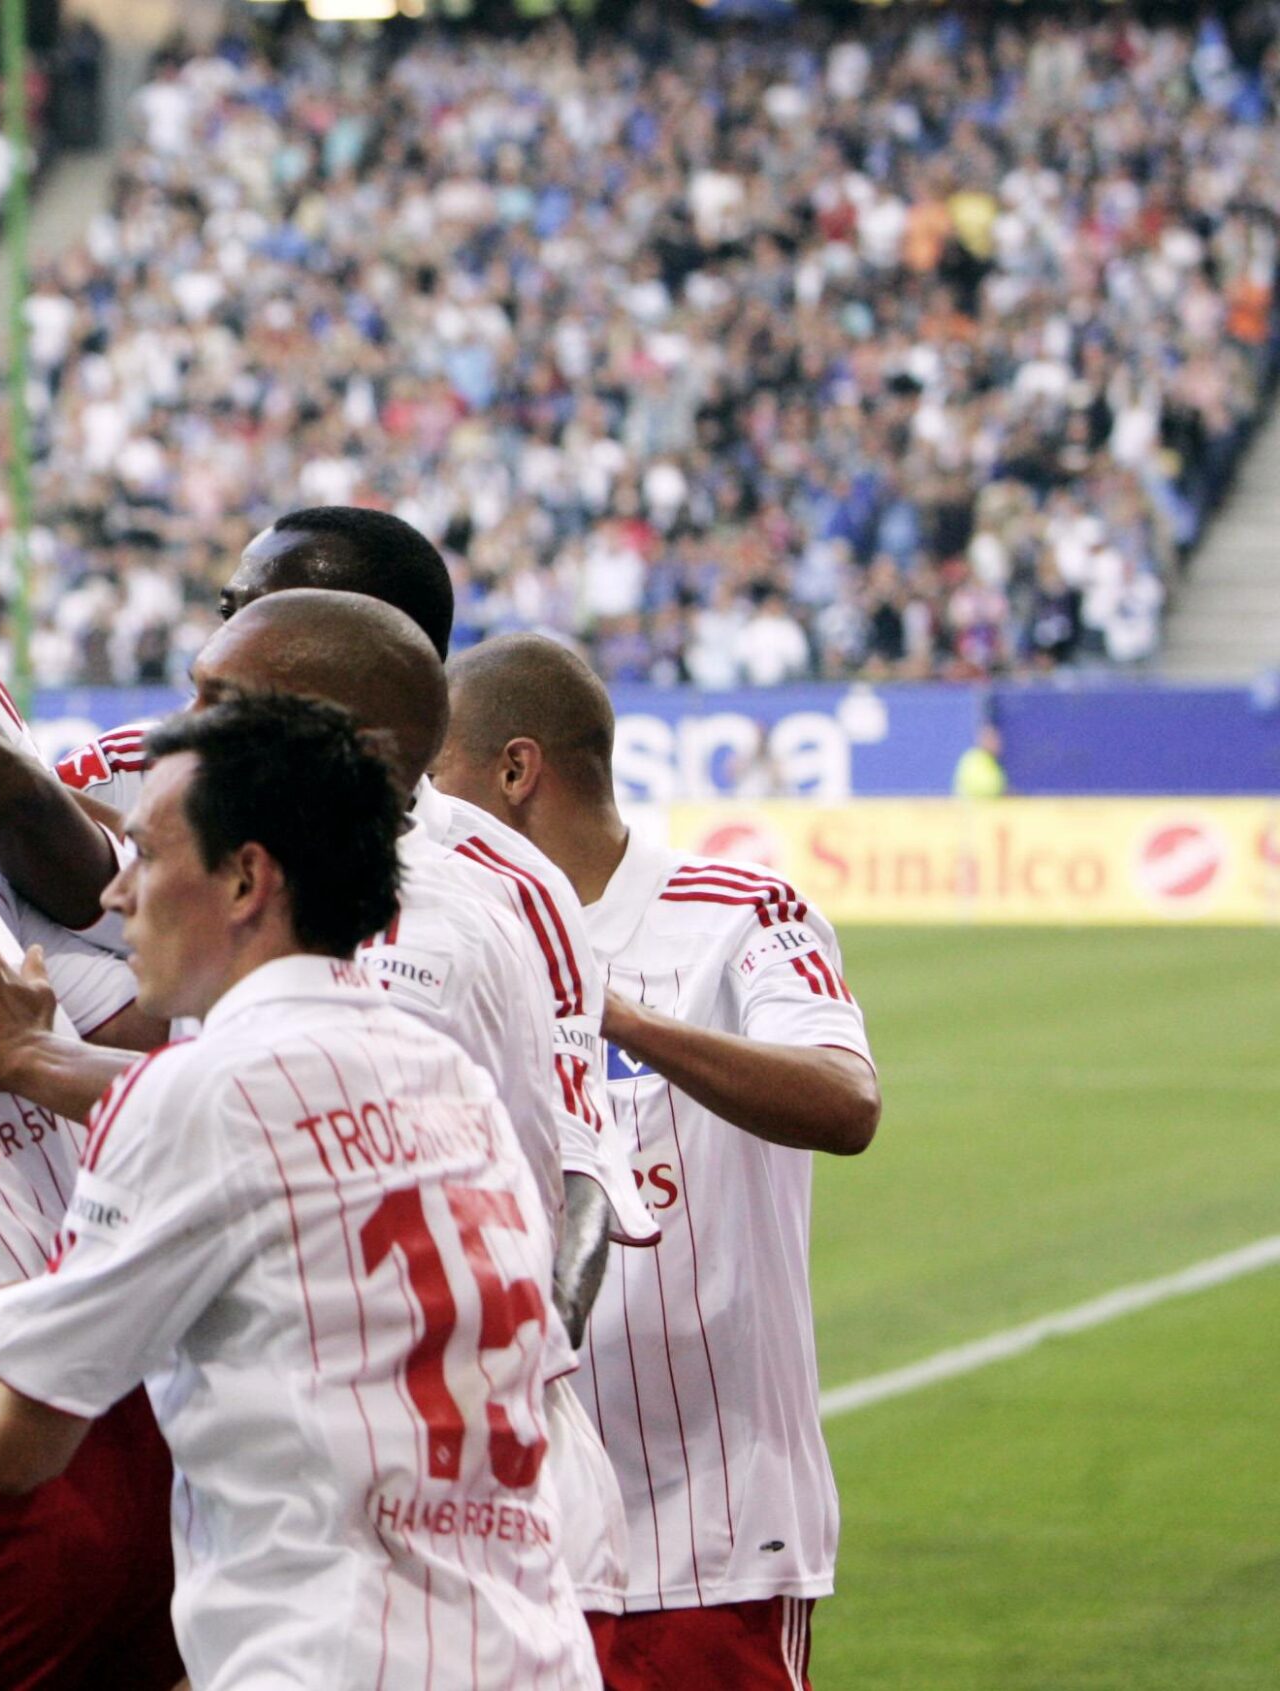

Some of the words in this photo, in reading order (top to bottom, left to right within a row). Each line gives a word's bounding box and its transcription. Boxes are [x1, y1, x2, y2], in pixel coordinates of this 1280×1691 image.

[613, 711, 852, 800] spa
[808, 811, 1107, 900] Sinalco
[359, 1181, 547, 1489] 15
